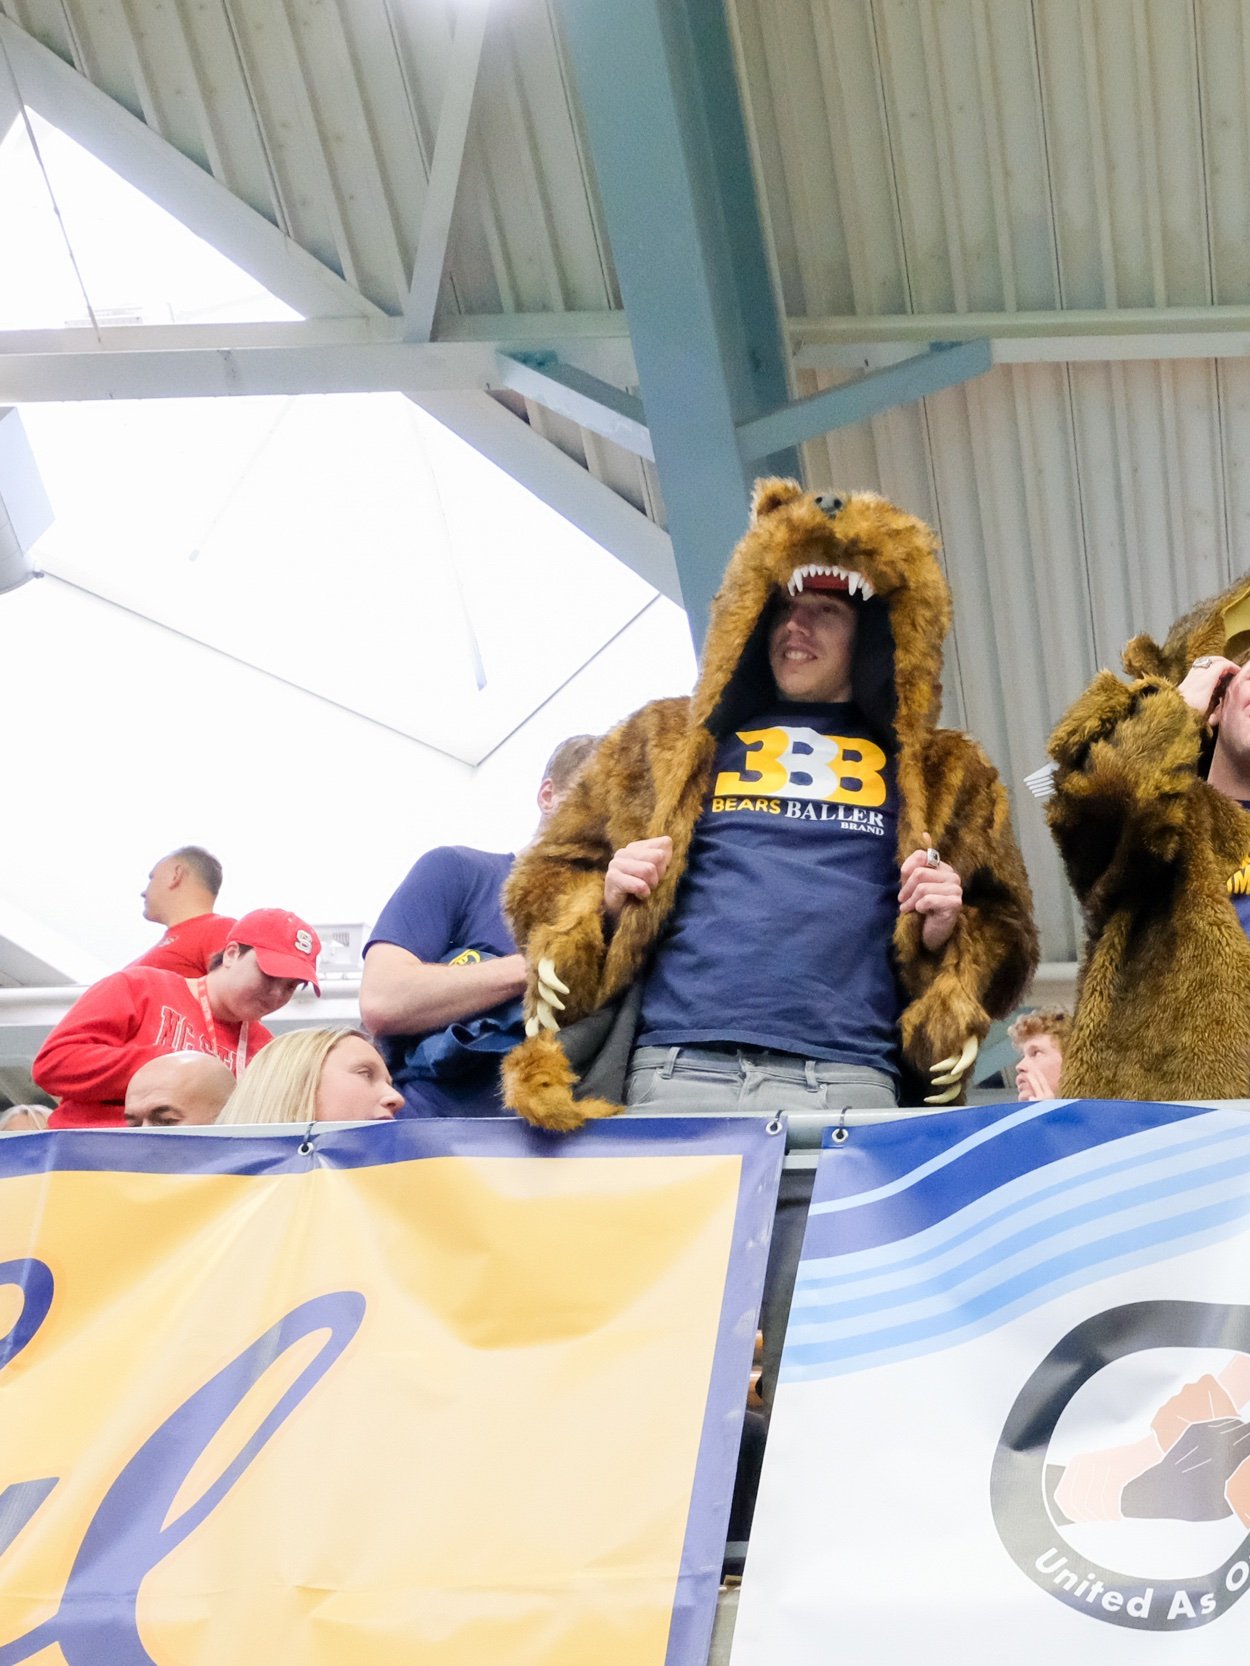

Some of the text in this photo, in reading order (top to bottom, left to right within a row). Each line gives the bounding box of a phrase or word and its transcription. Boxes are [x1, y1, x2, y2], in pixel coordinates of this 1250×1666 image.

[712, 799, 885, 828] BEARS BALLER
[840, 822, 885, 836] BRAND
[1035, 1547, 1154, 1619] United
[1167, 1590, 1217, 1620] As
